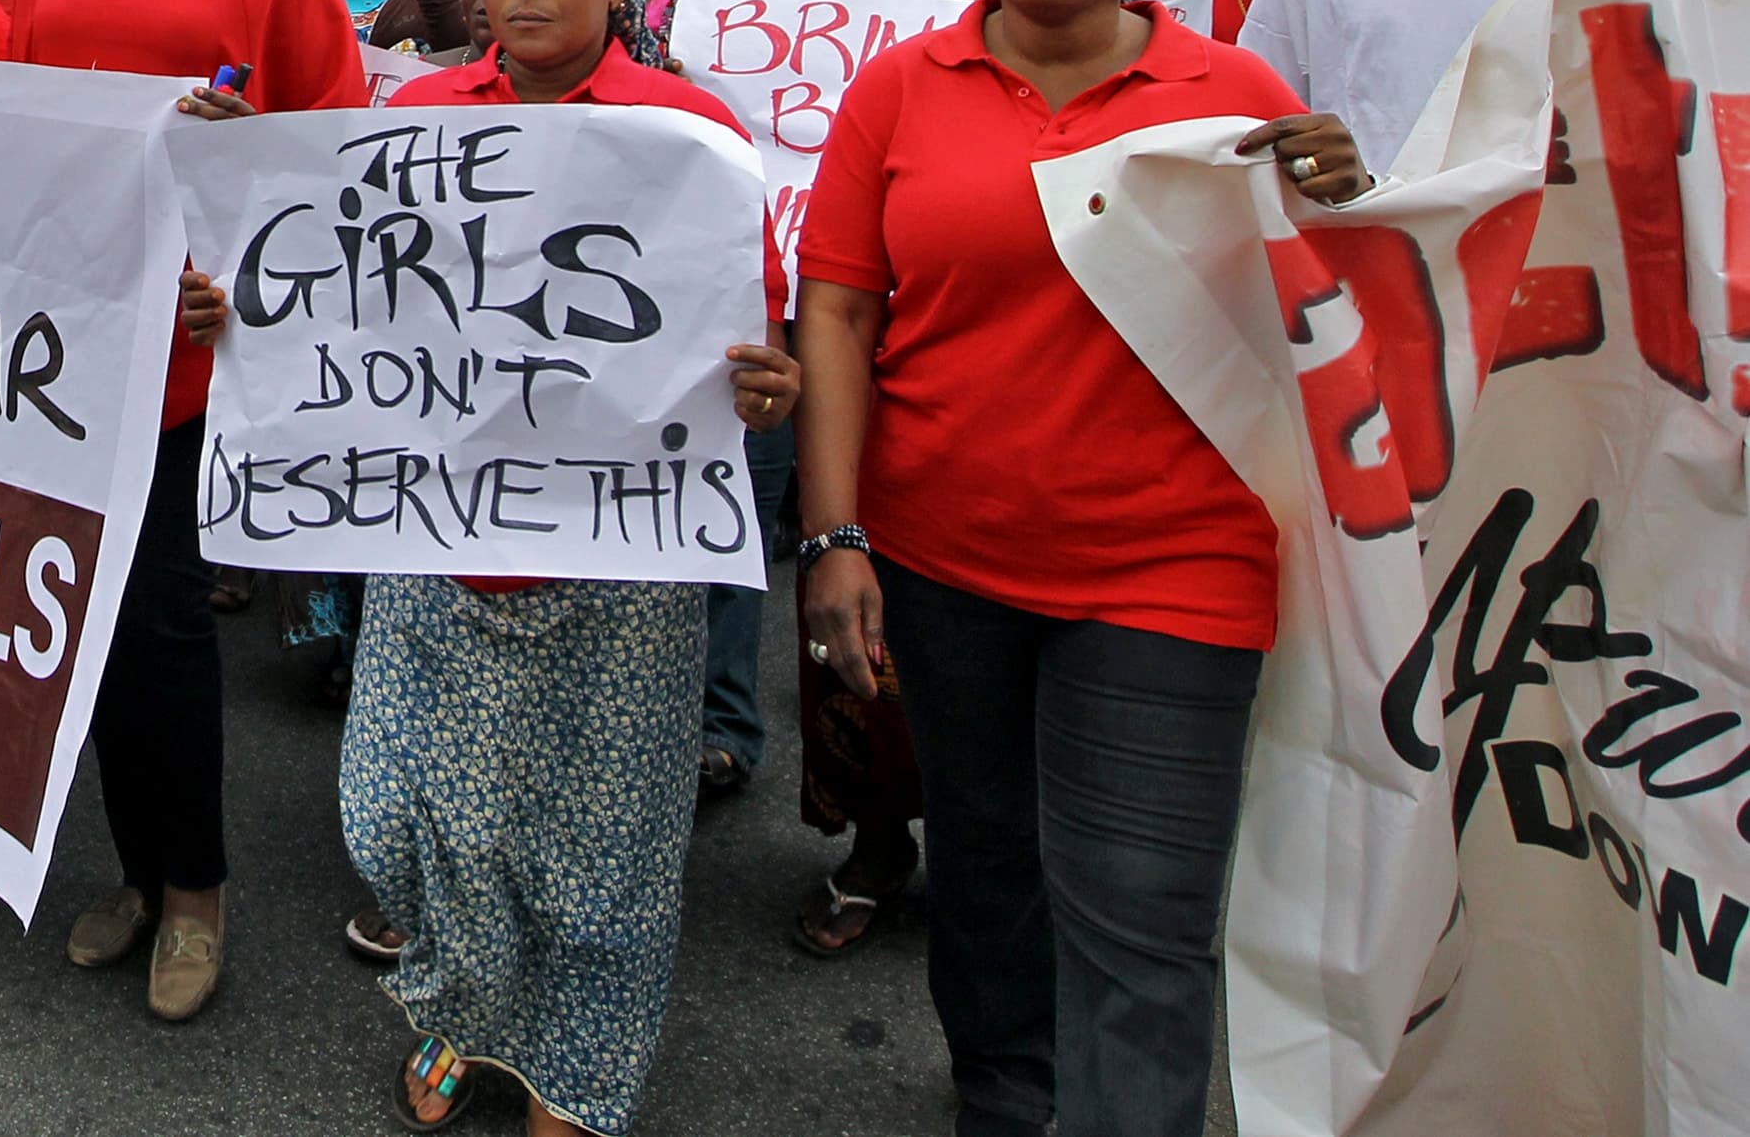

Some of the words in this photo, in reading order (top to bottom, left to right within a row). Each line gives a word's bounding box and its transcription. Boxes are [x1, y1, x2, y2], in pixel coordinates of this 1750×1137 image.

[337, 124, 534, 207] THE
[294, 343, 592, 429] DON'T
[198, 434, 559, 550] DESERVE
